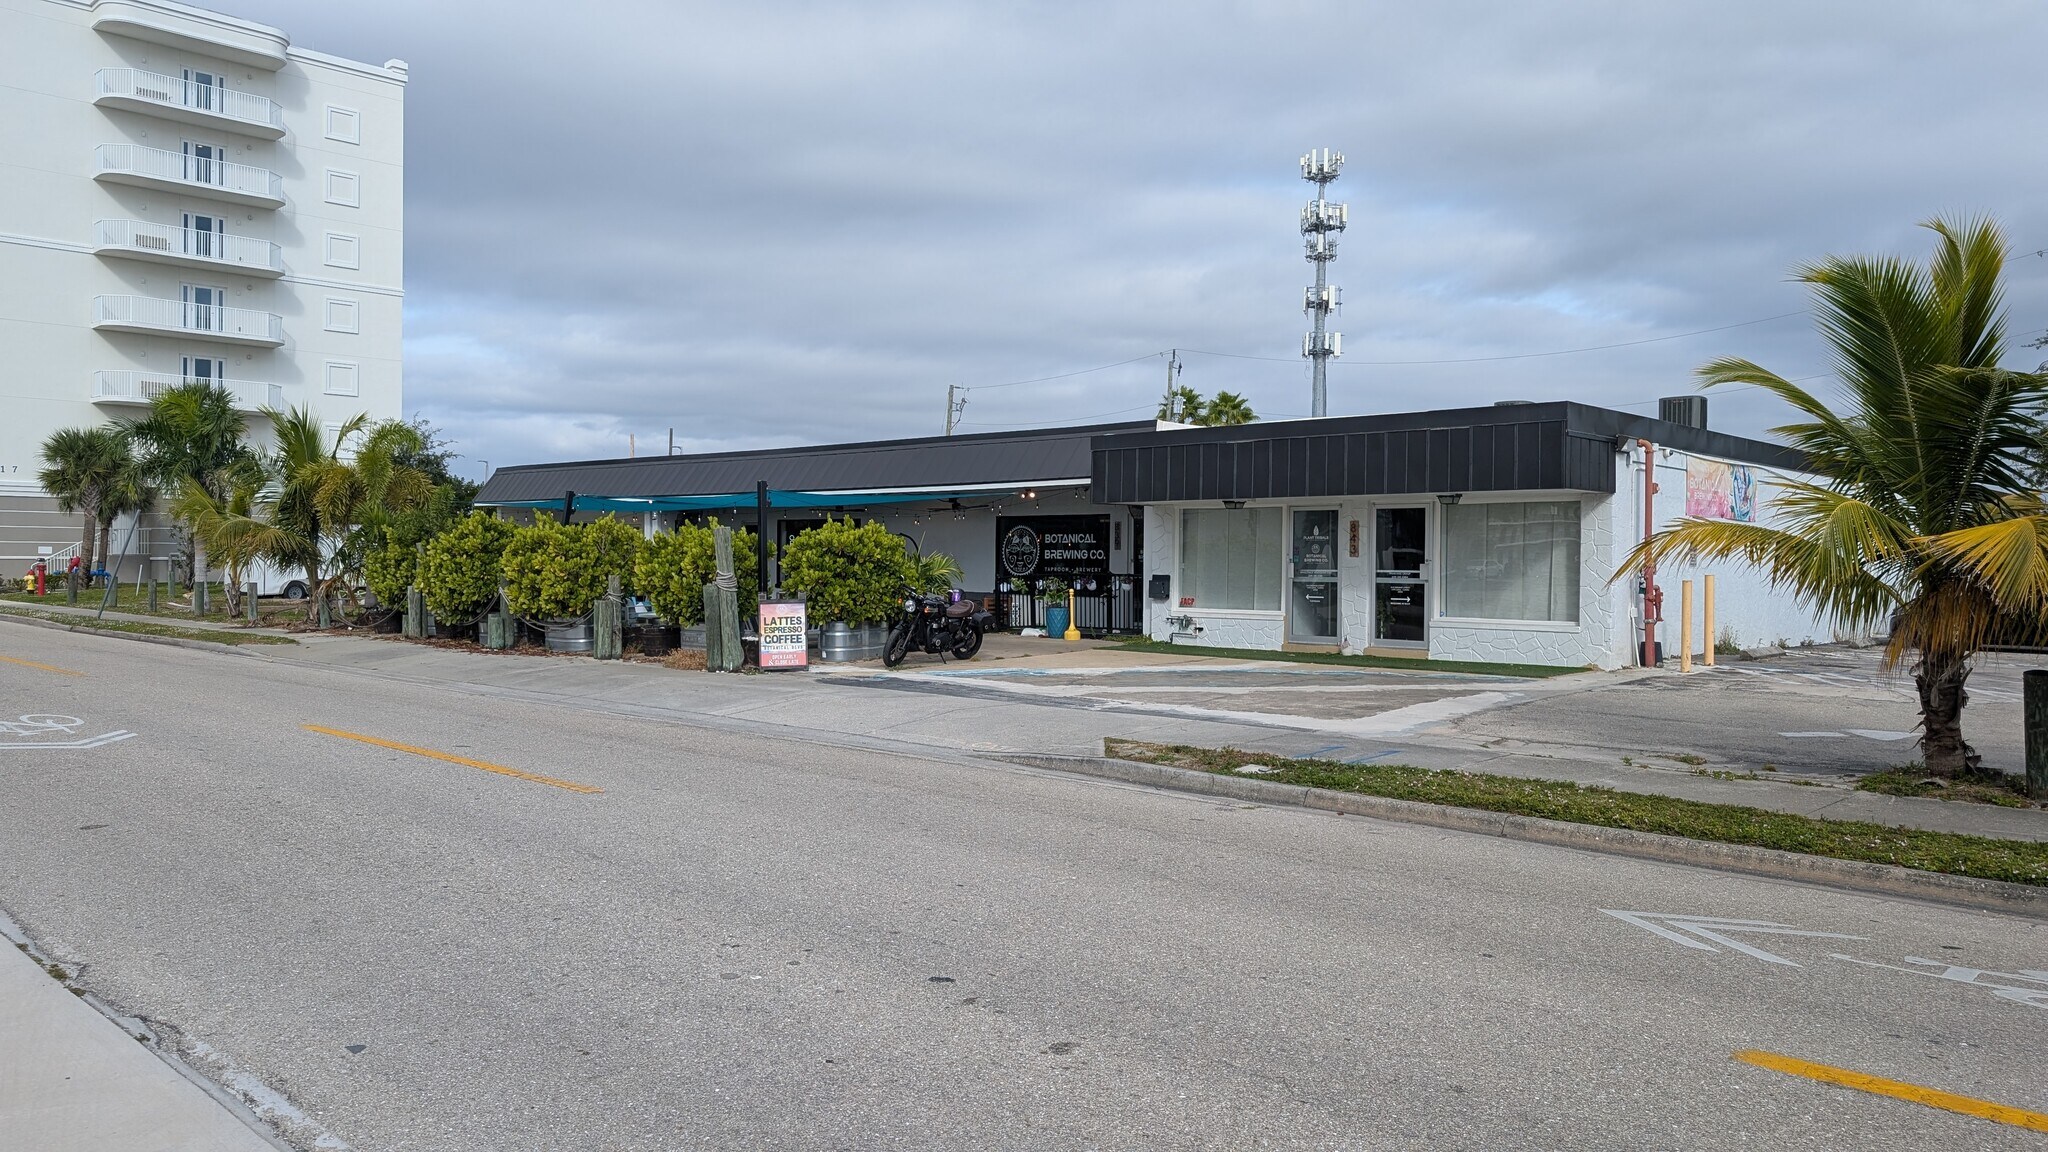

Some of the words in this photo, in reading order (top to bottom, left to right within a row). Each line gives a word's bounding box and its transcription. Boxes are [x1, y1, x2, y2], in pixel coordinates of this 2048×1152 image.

[1044, 533, 1097, 544] BOTANICAL
[1044, 549, 1088, 559] BREWING
[1089, 549, 1106, 560] CO.
[763, 616, 803, 626] LATTES
[763, 626, 803, 634] ESPRESSO
[764, 634, 803, 644] COFFEE
